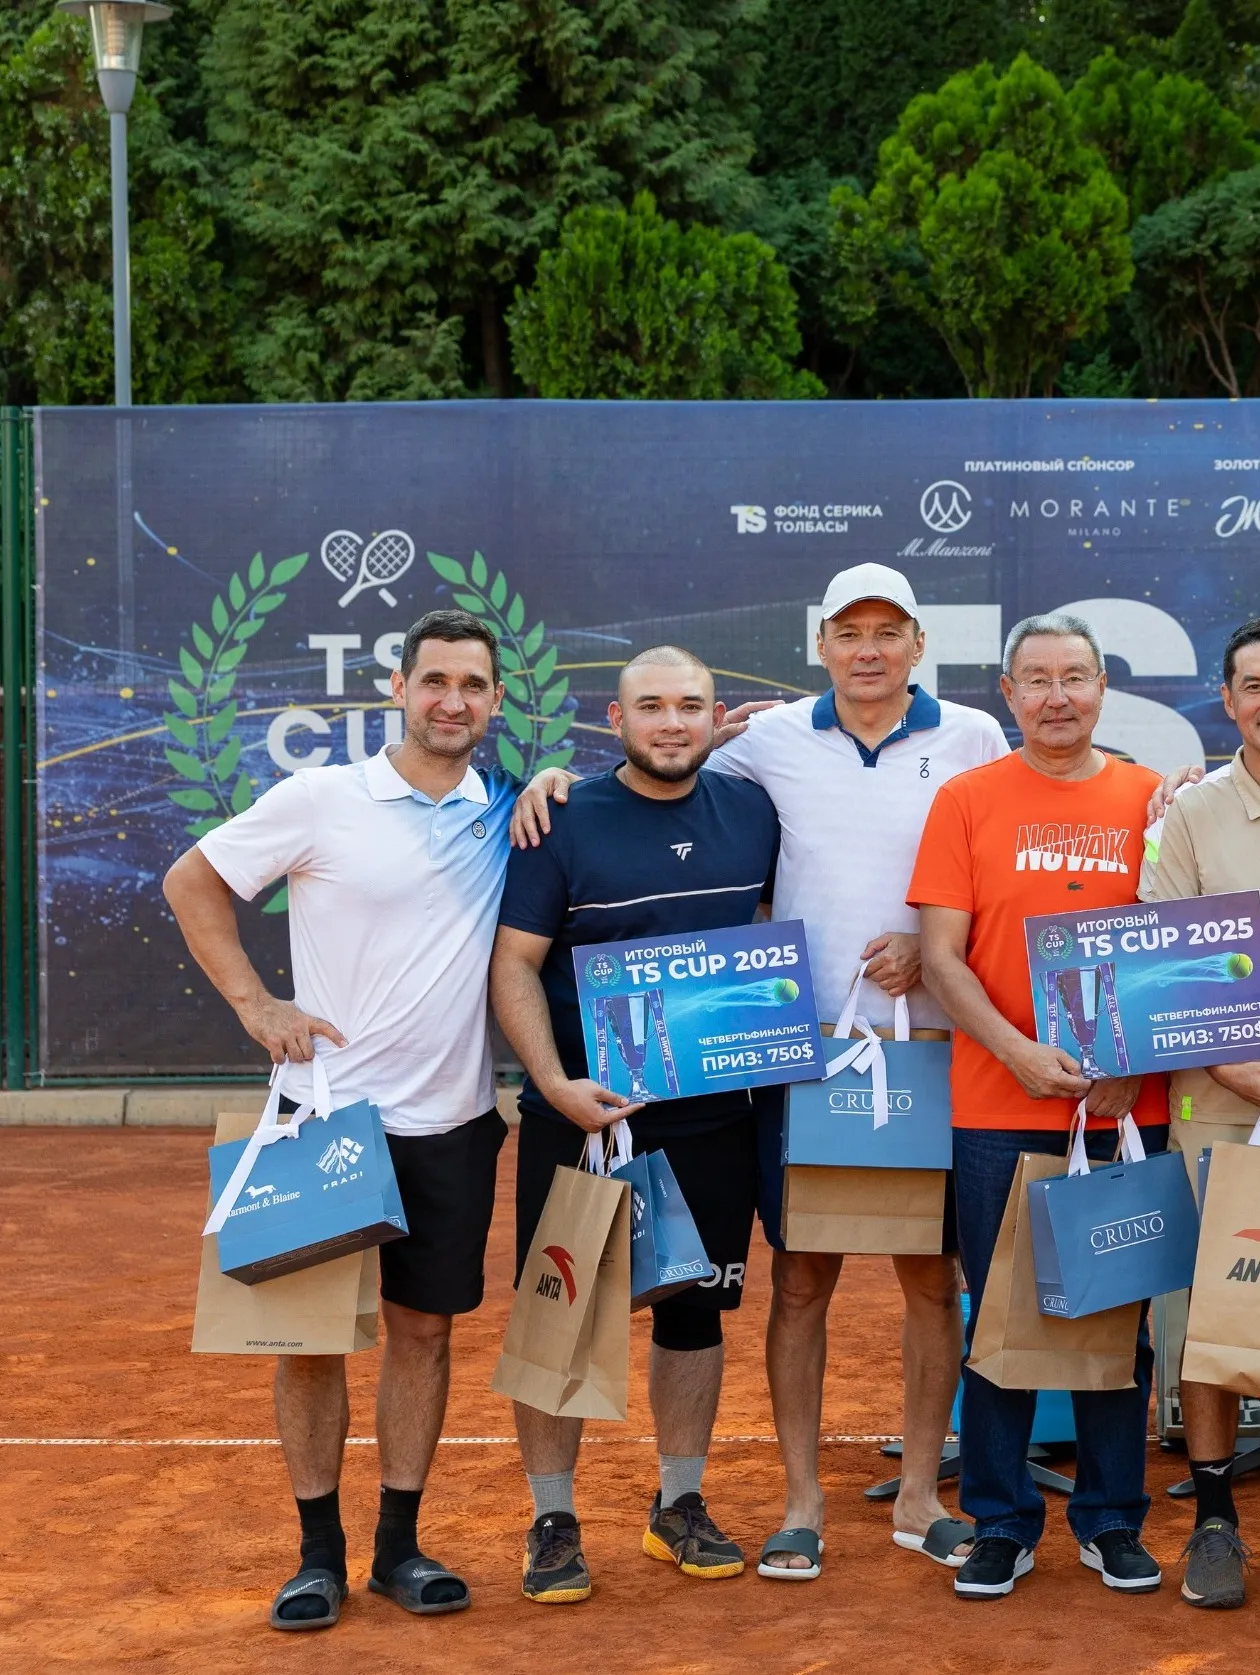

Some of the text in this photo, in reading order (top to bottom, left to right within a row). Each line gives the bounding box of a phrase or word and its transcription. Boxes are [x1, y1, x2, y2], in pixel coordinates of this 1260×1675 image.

[965, 458, 1135, 472] ПЛАТИНОВЫЙ СПОНСОР
[774, 504, 883, 519] ФОНД СЕРИКА
[1009, 499, 1179, 518] MORANTE
[730, 505, 767, 534] TS
[774, 521, 848, 533] ТОЛБАСЫ
[1068, 527, 1121, 537] MILANO
[1015, 823, 1129, 874] NOVAK
[1076, 910, 1159, 934] ИТОГОВЫЙ
[1046, 940, 1065, 949] CUP
[1078, 917, 1254, 958] TS CUP 2025
[624, 938, 706, 962] ИТОГОВЫЙ
[594, 968, 613, 976] CUP
[625, 944, 799, 986] TS CUP 2025
[698, 1023, 810, 1046] ЧЕТВЕРТЬФИНАЛИСТ
[1152, 1029, 1214, 1050] ПРИЗ:
[702, 1042, 814, 1073] ПРИЗ: 750$
[323, 1171, 363, 1190] FRADI
[262, 1197, 271, 1208] &
[272, 1191, 301, 1205] Blaine
[1090, 1216, 1165, 1250] CRUNO
[660, 1263, 704, 1280] CRUNO
[535, 1272, 562, 1301] ANTA
[246, 1338, 303, 1348] www.anta.com
